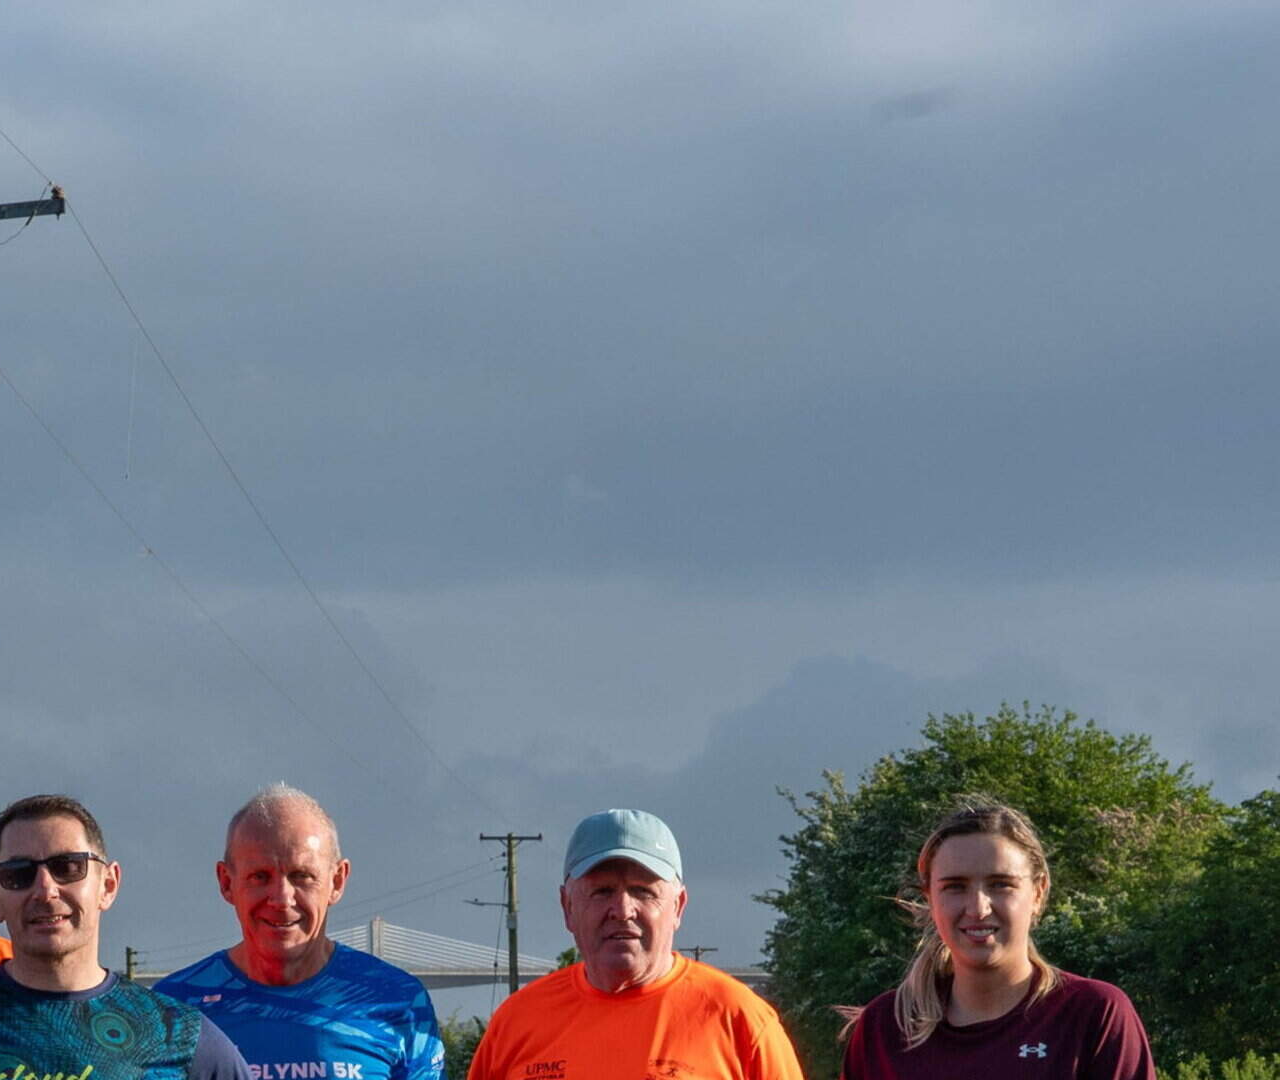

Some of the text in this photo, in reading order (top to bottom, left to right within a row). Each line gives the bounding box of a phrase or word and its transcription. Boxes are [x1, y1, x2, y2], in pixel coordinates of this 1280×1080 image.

[248, 1061, 364, 1080] GLYNN 5K
[526, 1060, 566, 1076] UPMC
